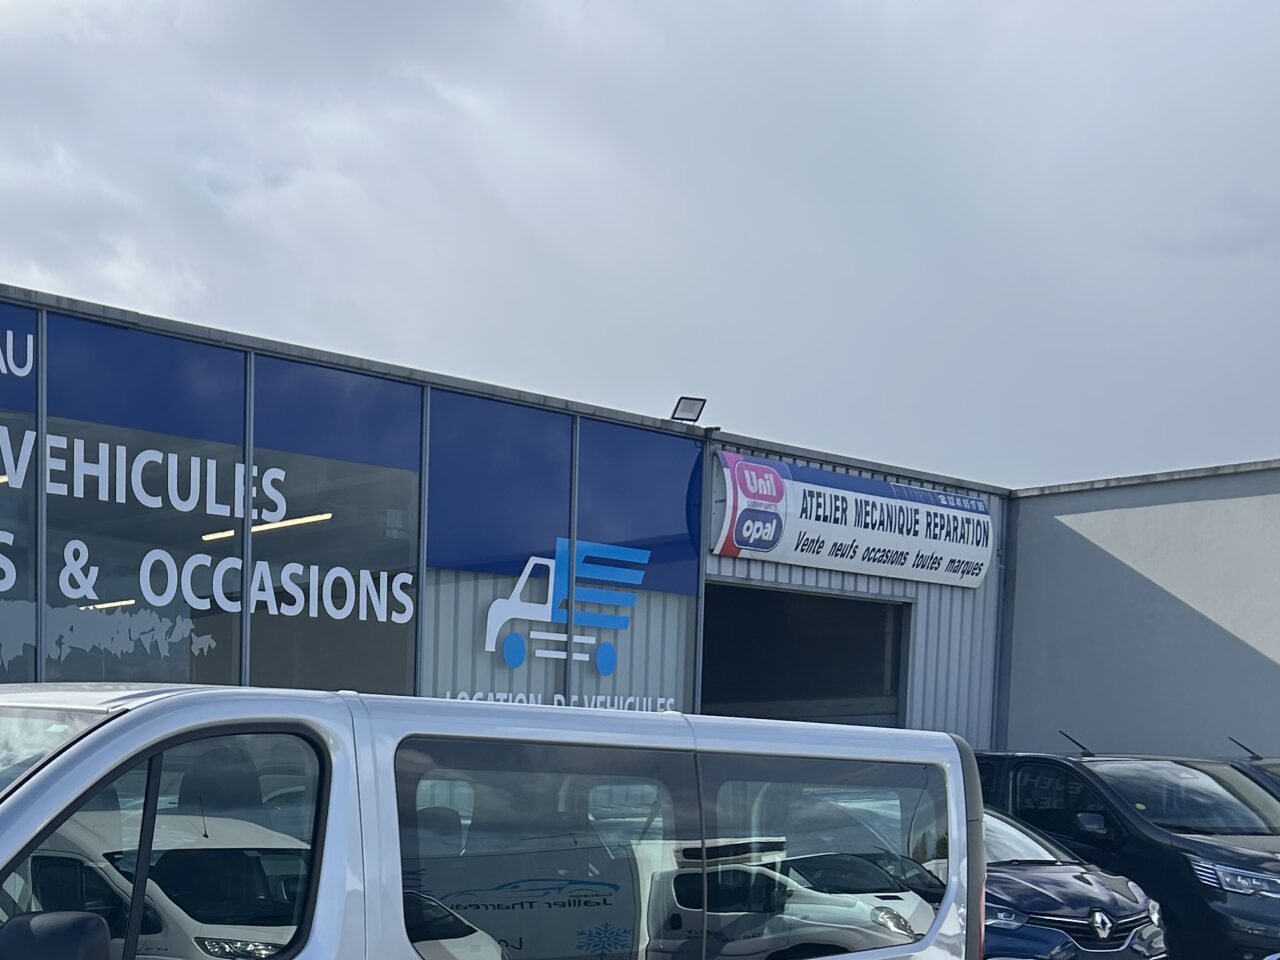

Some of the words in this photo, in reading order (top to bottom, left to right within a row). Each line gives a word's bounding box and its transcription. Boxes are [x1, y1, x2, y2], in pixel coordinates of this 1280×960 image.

[743, 469, 777, 497] Unil
[742, 519, 777, 544] opal
[800, 489, 848, 526] ATELIER
[854, 498, 920, 537] MECANIQUE
[925, 511, 990, 548] REPARATION
[794, 531, 824, 555] Vente
[831, 540, 859, 560] neufs
[861, 546, 909, 567] occasions
[912, 550, 942, 573] toutes
[944, 558, 984, 580] marques
[58, 539, 99, 601] &
[140, 548, 414, 624] OCCASIONS
